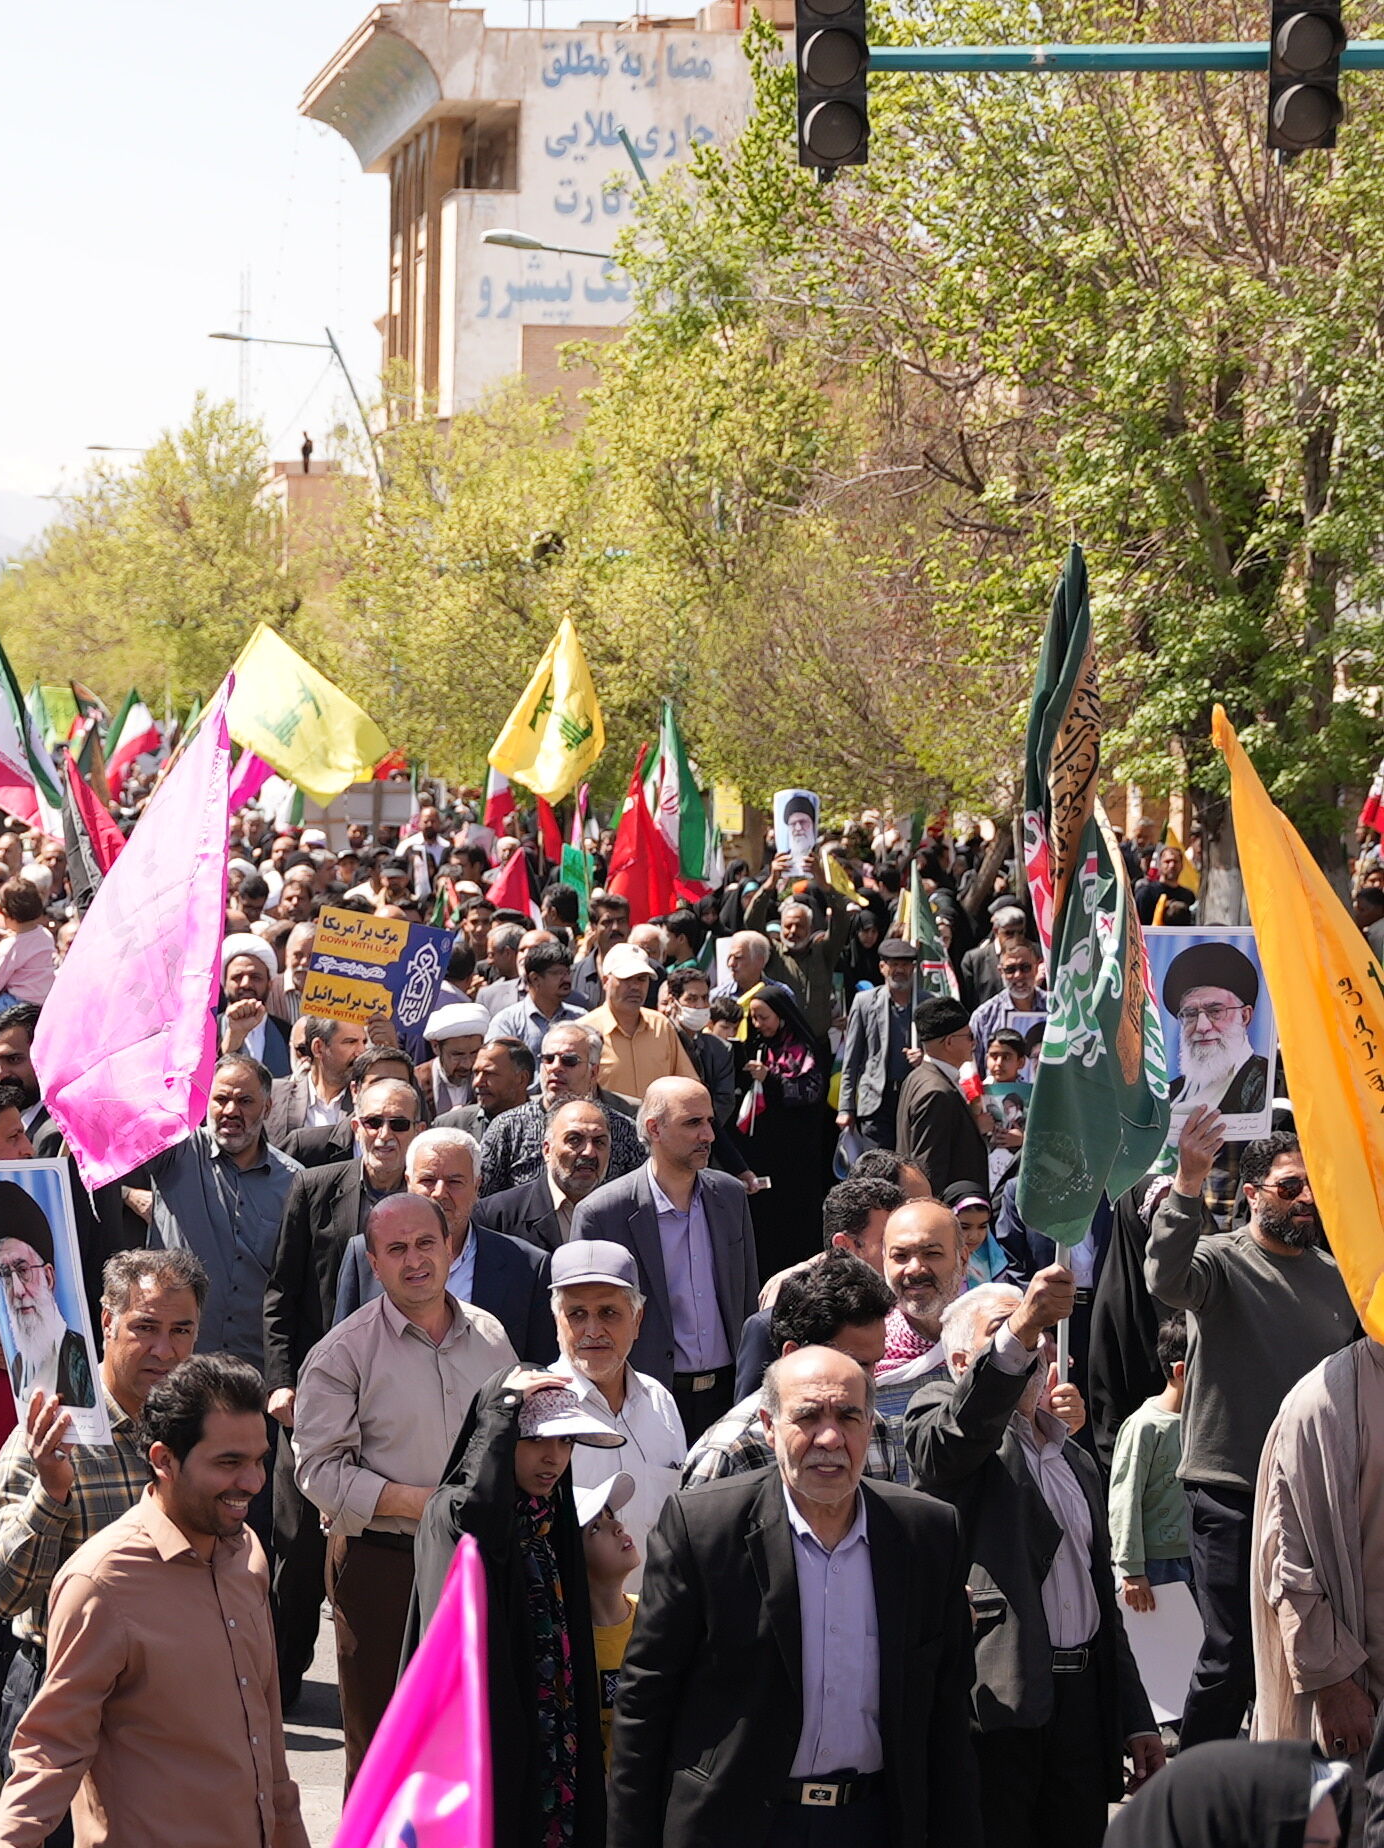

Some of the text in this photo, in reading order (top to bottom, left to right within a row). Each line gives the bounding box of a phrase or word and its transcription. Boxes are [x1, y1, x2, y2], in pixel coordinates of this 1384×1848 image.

[542, 39, 610, 88] مطلق
[322, 915, 399, 945] مرگ بر آمریکا
[319, 934, 349, 947] DOWN
[351, 938, 375, 951] WITH
[303, 1003, 331, 1015] DOWN
[333, 1008, 356, 1020] WITH
